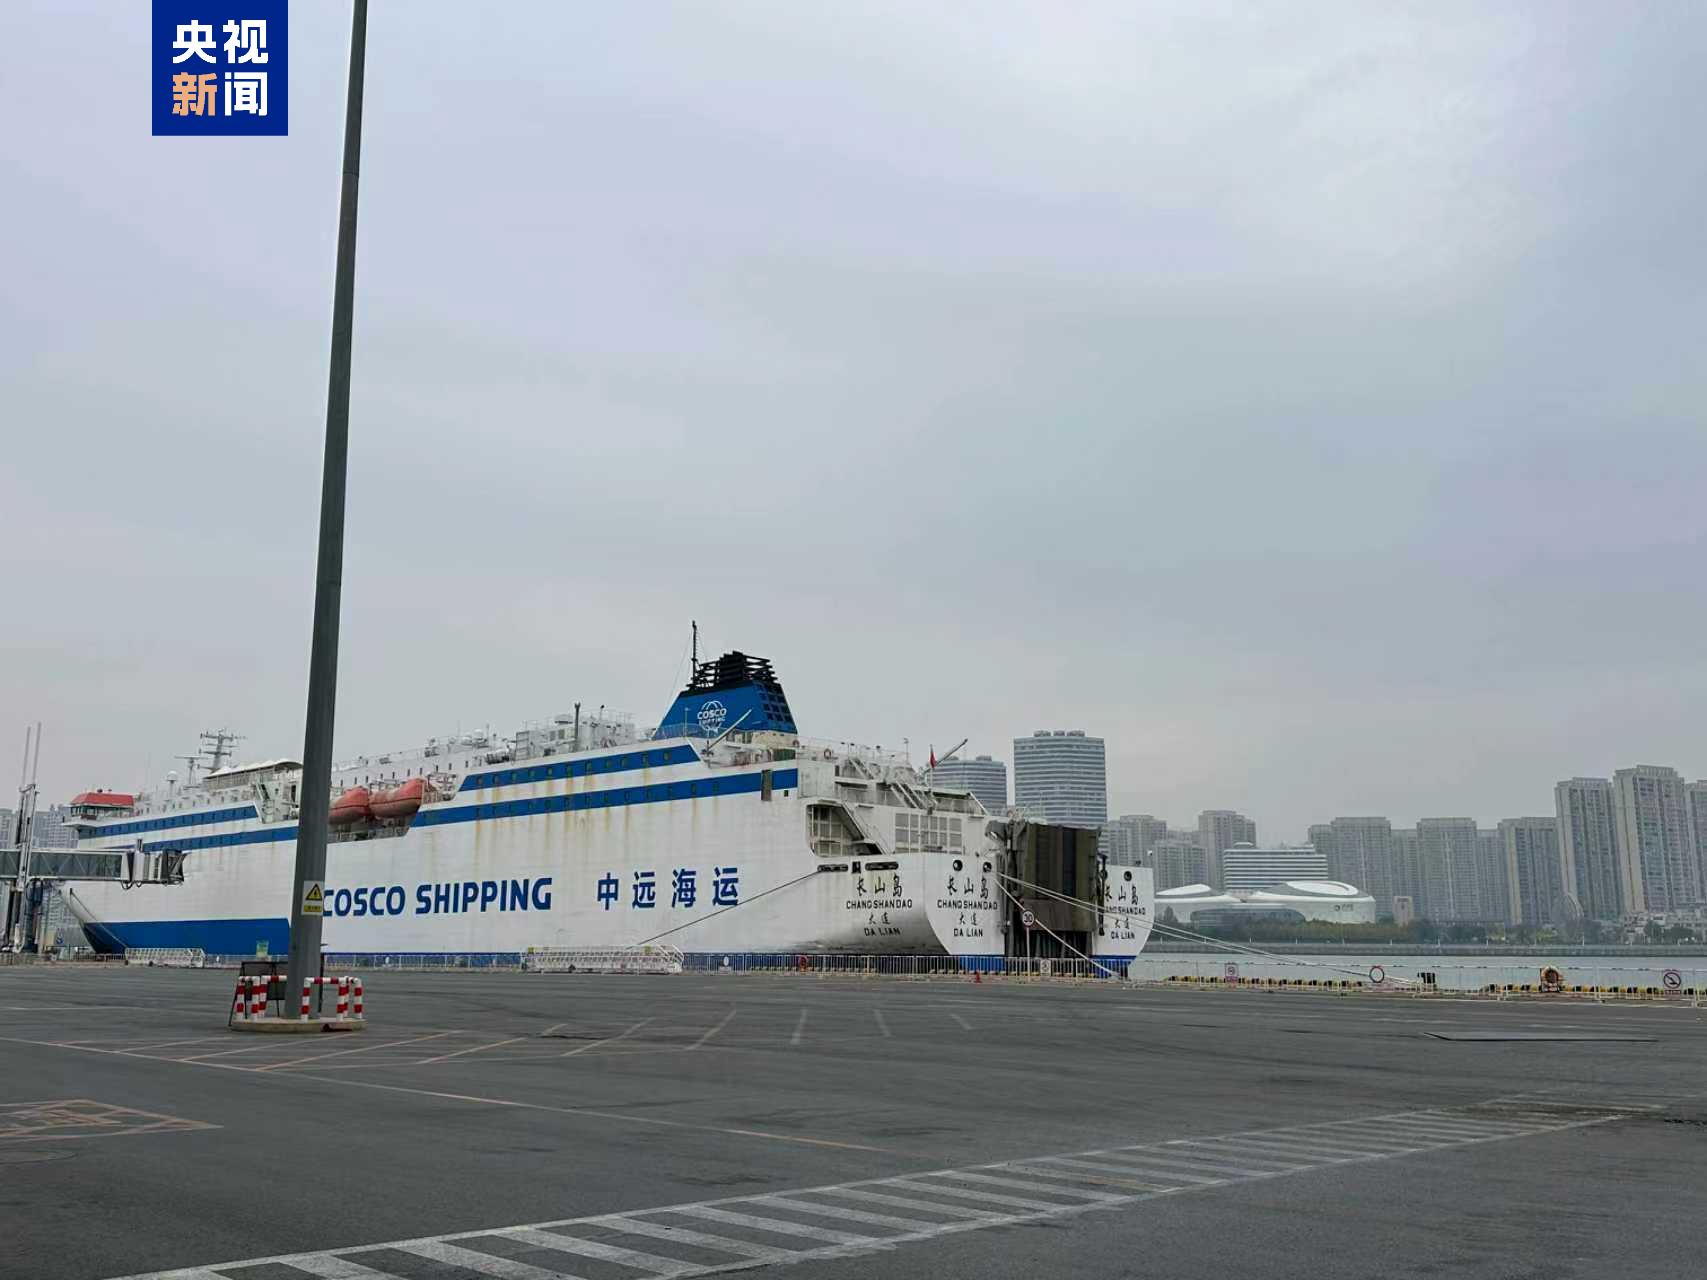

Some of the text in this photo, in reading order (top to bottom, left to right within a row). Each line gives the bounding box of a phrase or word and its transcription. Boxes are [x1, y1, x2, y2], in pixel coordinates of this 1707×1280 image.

[697, 708, 727, 720] COSCO
[597, 866, 740, 910] 中远海运
[323, 877, 553, 917] COSCO SHIPPING
[846, 899, 913, 910] CHANGSHANDAO
[937, 899, 998, 910] CHANGSHANDAO
[864, 927, 903, 937] DA LIAN
[953, 928, 984, 938] DA LIAN
